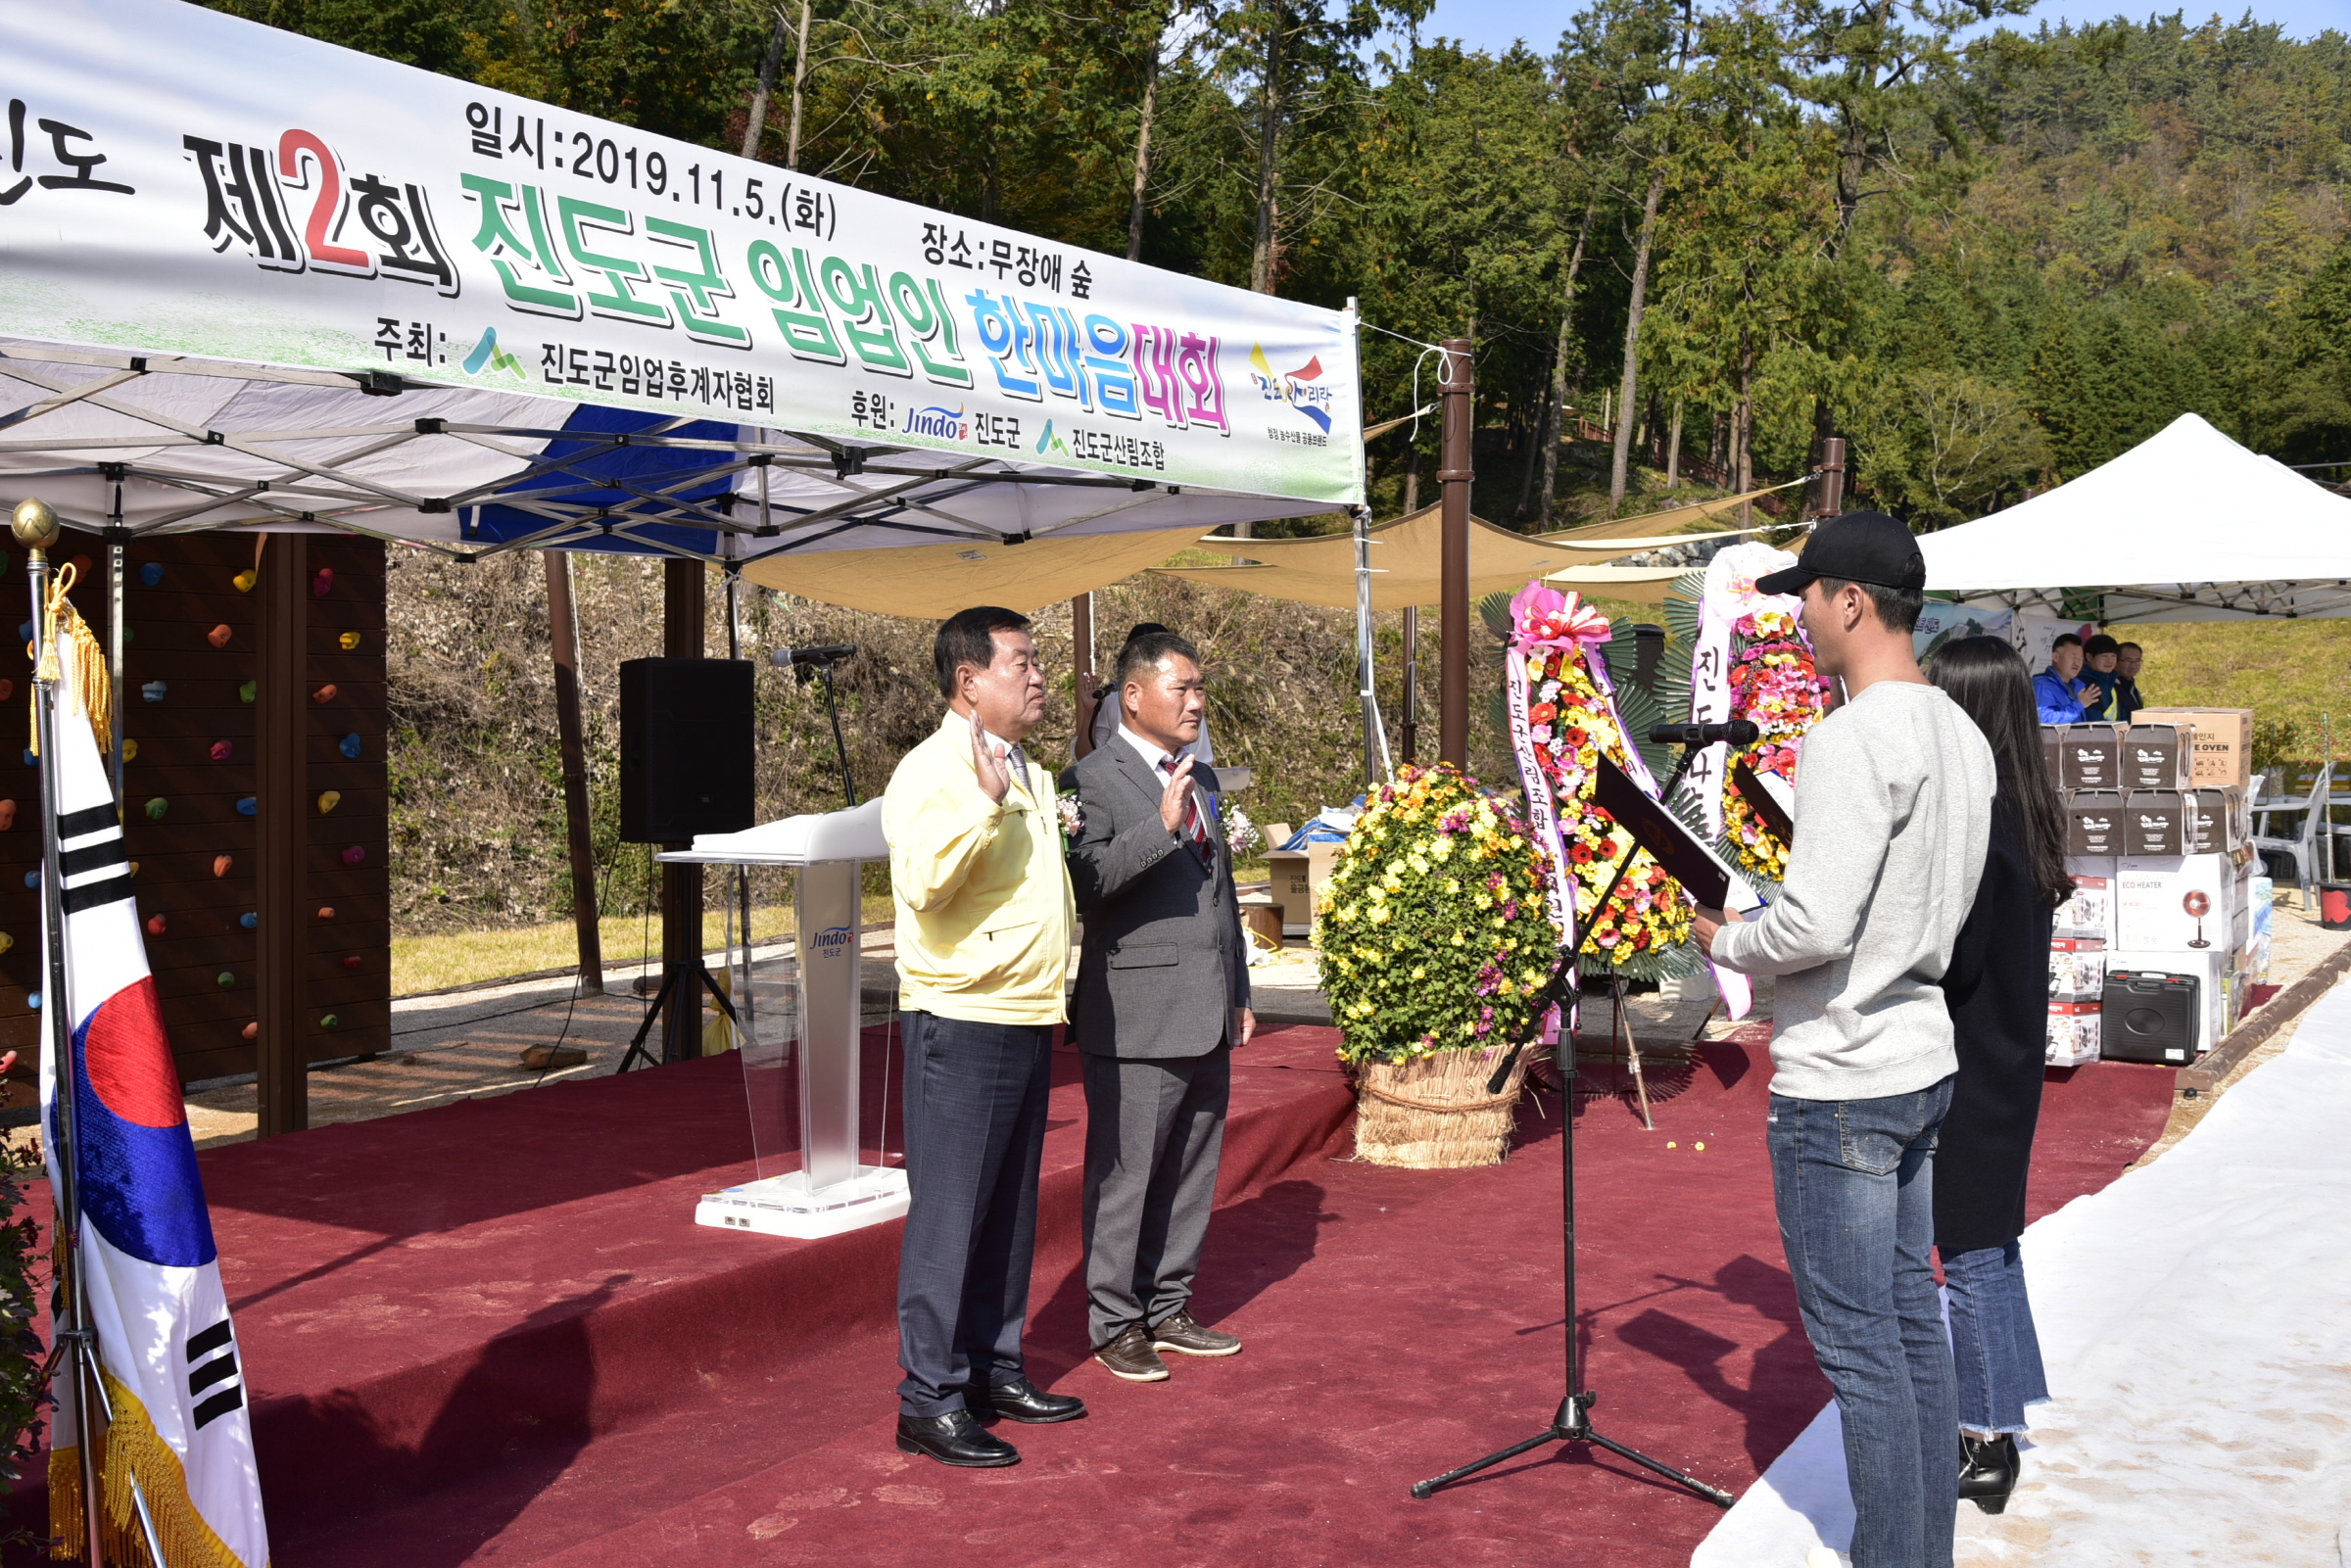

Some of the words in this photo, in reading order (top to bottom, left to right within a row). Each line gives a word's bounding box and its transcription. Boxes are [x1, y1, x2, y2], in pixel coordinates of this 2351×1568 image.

[182, 128, 458, 297] 제2회
[460, 172, 752, 349] 진도군
[746, 239, 973, 388] 임업인
[965, 288, 1230, 436] 한마음대회
[921, 222, 1063, 295] 장소:무장애
[1071, 260, 1092, 300] 숲
[374, 316, 447, 367] 주최:
[541, 343, 776, 415] 진도군임업후계자협회
[851, 390, 895, 431] 후원:
[902, 405, 958, 440] Jindo
[975, 412, 1021, 451] 진도군
[1073, 428, 1165, 472] 진도군산림조합
[810, 930, 847, 950] Jindo
[823, 947, 841, 959] 진도군
